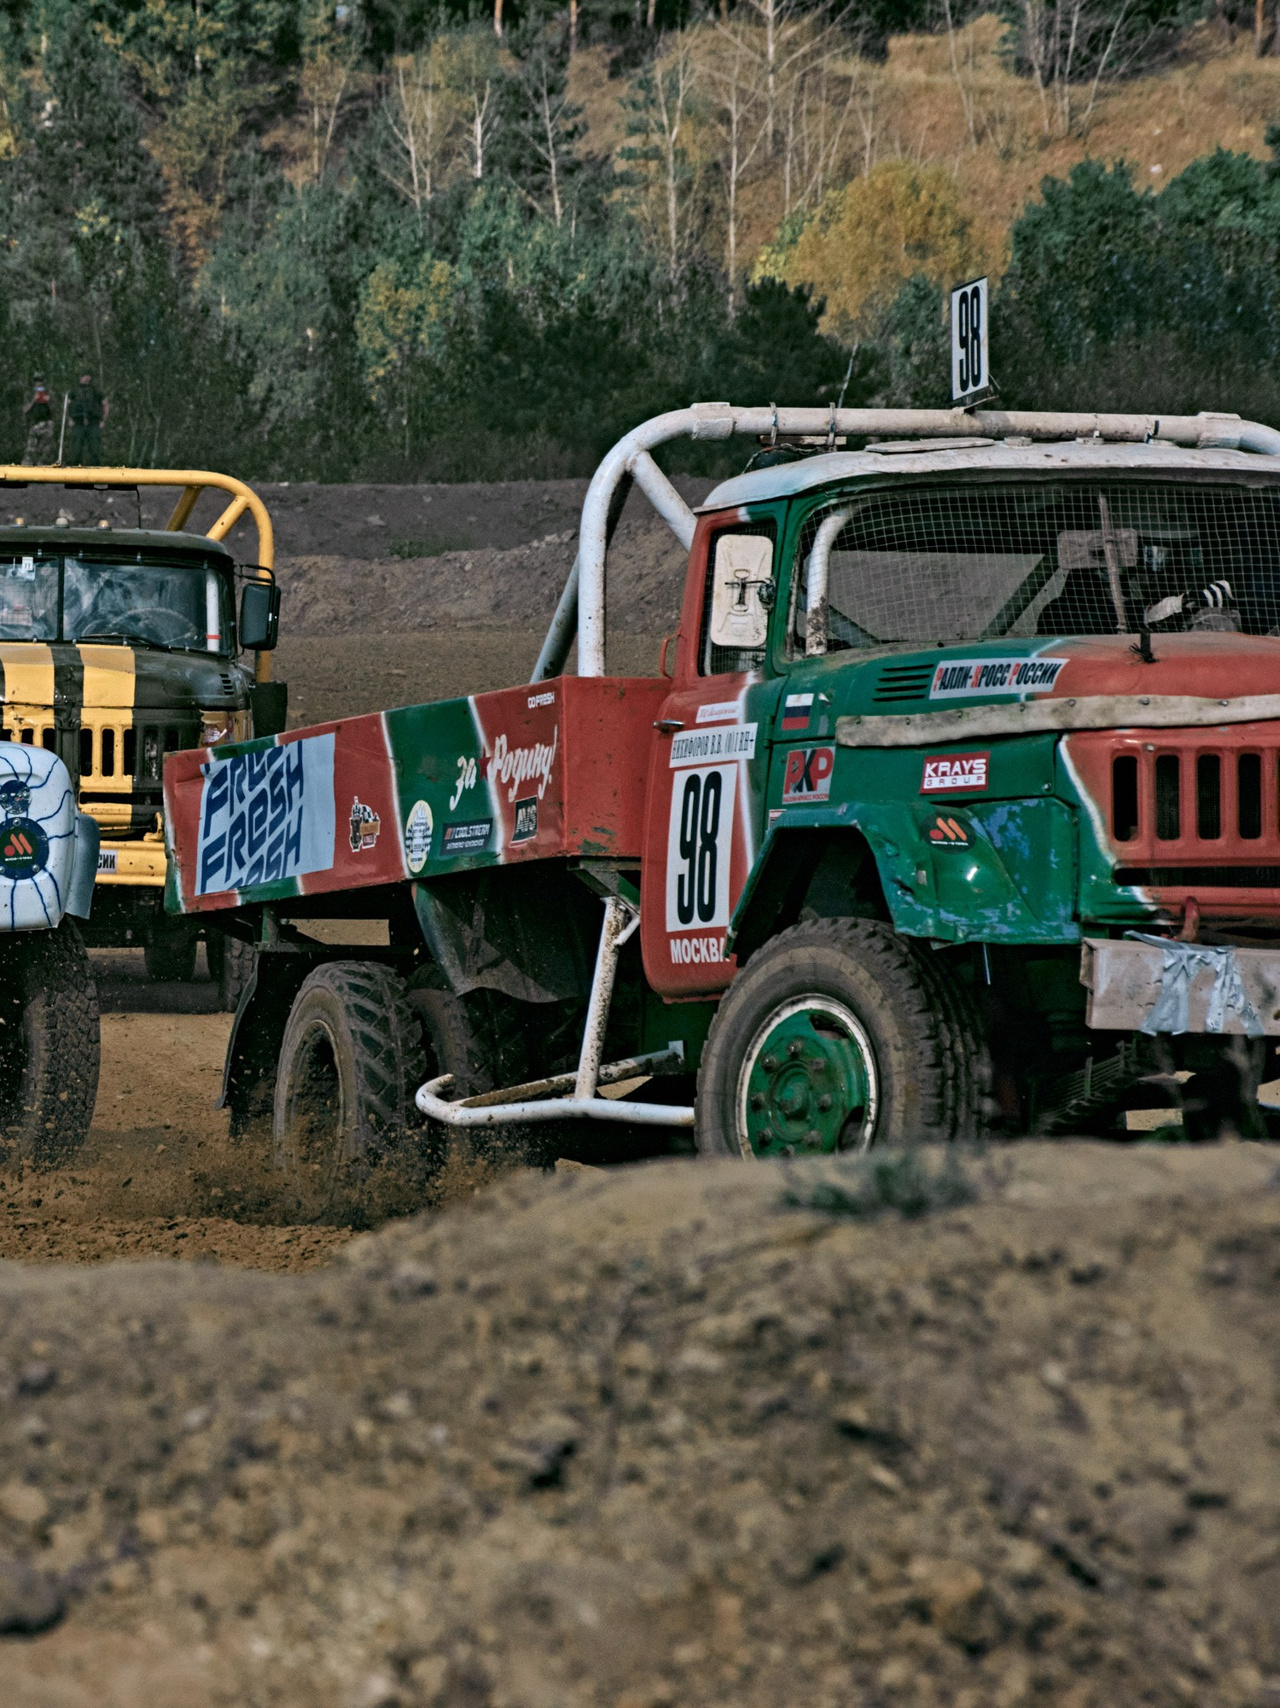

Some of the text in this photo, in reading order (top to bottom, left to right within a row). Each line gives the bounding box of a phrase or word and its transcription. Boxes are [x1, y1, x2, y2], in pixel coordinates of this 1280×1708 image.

[959, 286, 981, 392] 98
[933, 663, 1062, 691] РАЛЛИ-КРОСС РОССИИ
[449, 724, 558, 811] За Родину!
[925, 759, 987, 778] KRAYS
[926, 776, 983, 786] GROUP
[677, 771, 722, 924] 98
